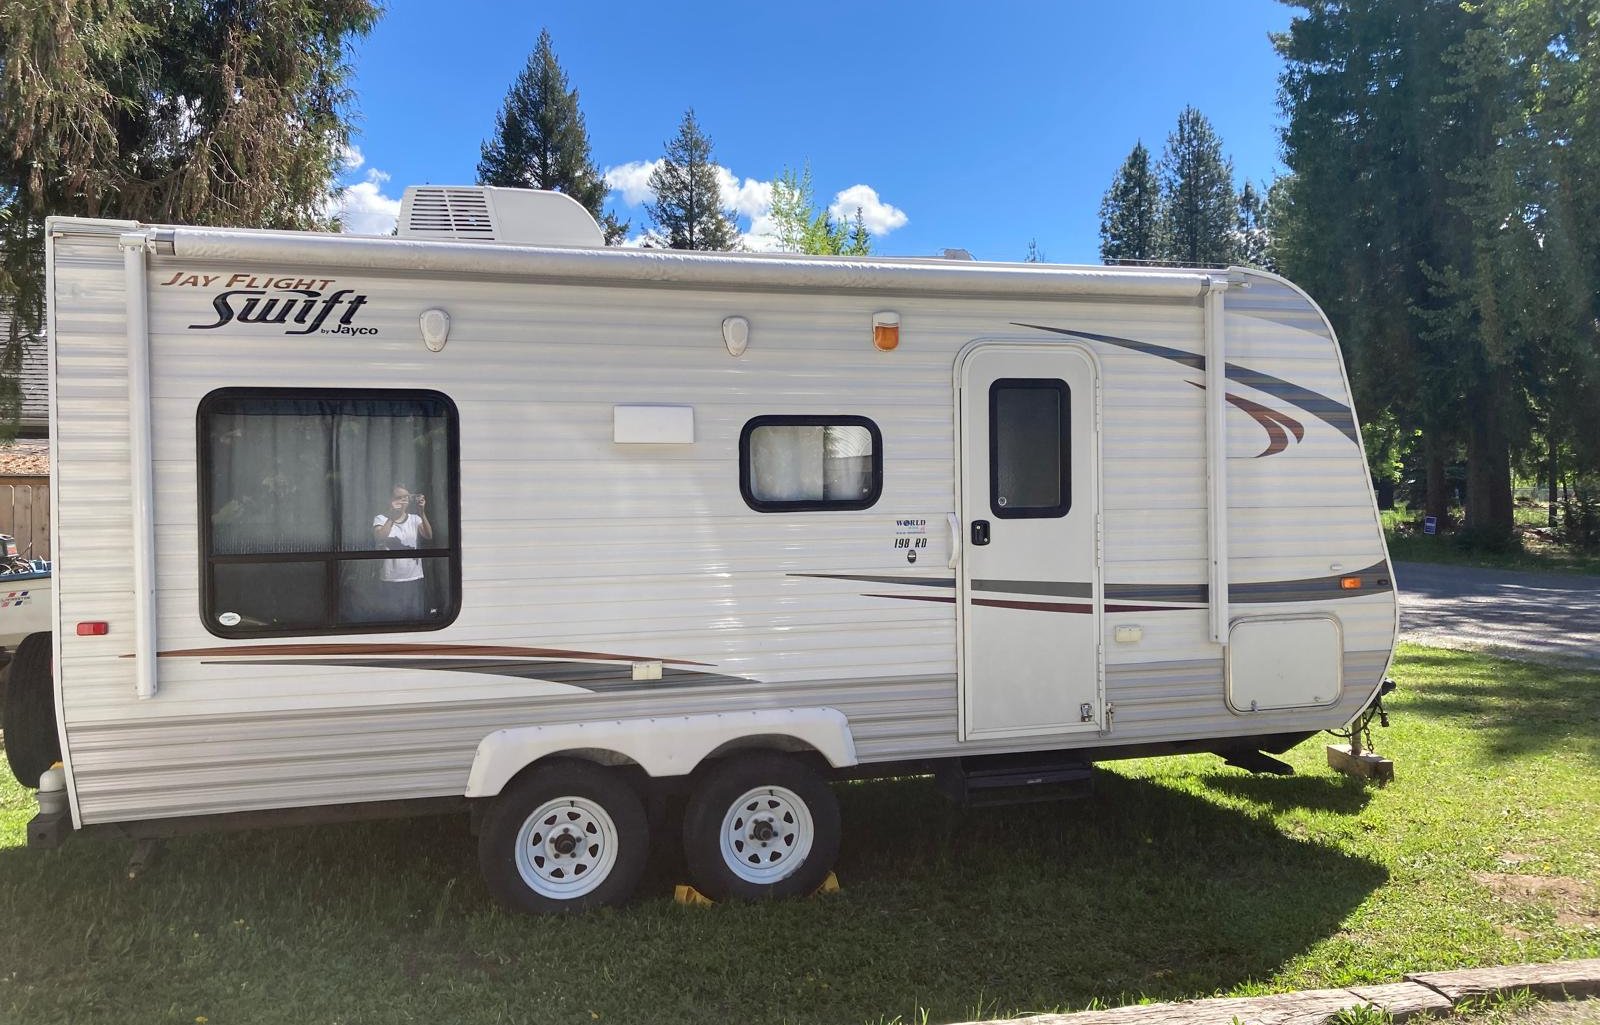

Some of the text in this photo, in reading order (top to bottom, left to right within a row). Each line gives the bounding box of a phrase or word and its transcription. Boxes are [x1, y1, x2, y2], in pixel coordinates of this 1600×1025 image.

[188, 290, 368, 335] Swift
[331, 324, 378, 336] Jayco
[894, 538, 910, 549] 198
